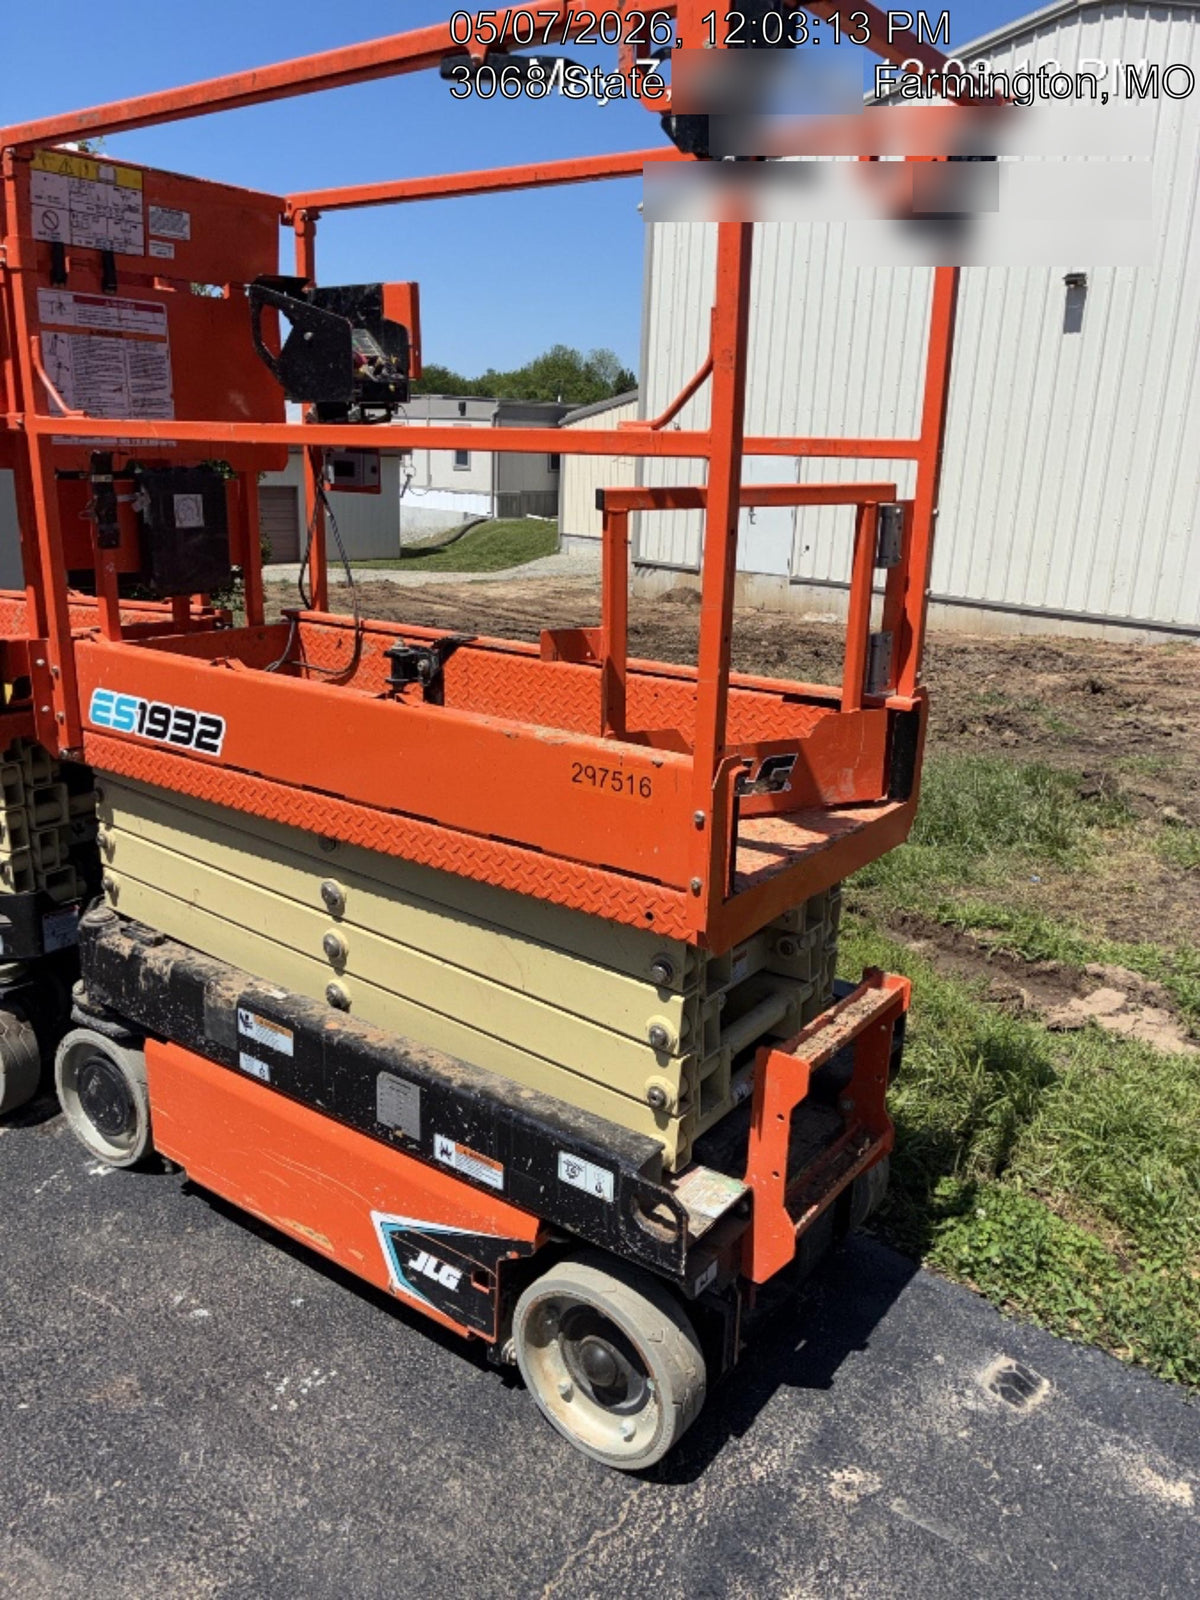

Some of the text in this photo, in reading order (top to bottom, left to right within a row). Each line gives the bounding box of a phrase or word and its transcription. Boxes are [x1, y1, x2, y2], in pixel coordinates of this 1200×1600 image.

[91, 690, 223, 753] ES1932
[571, 762, 652, 798] 297516
[408, 1250, 464, 1293] JLG
